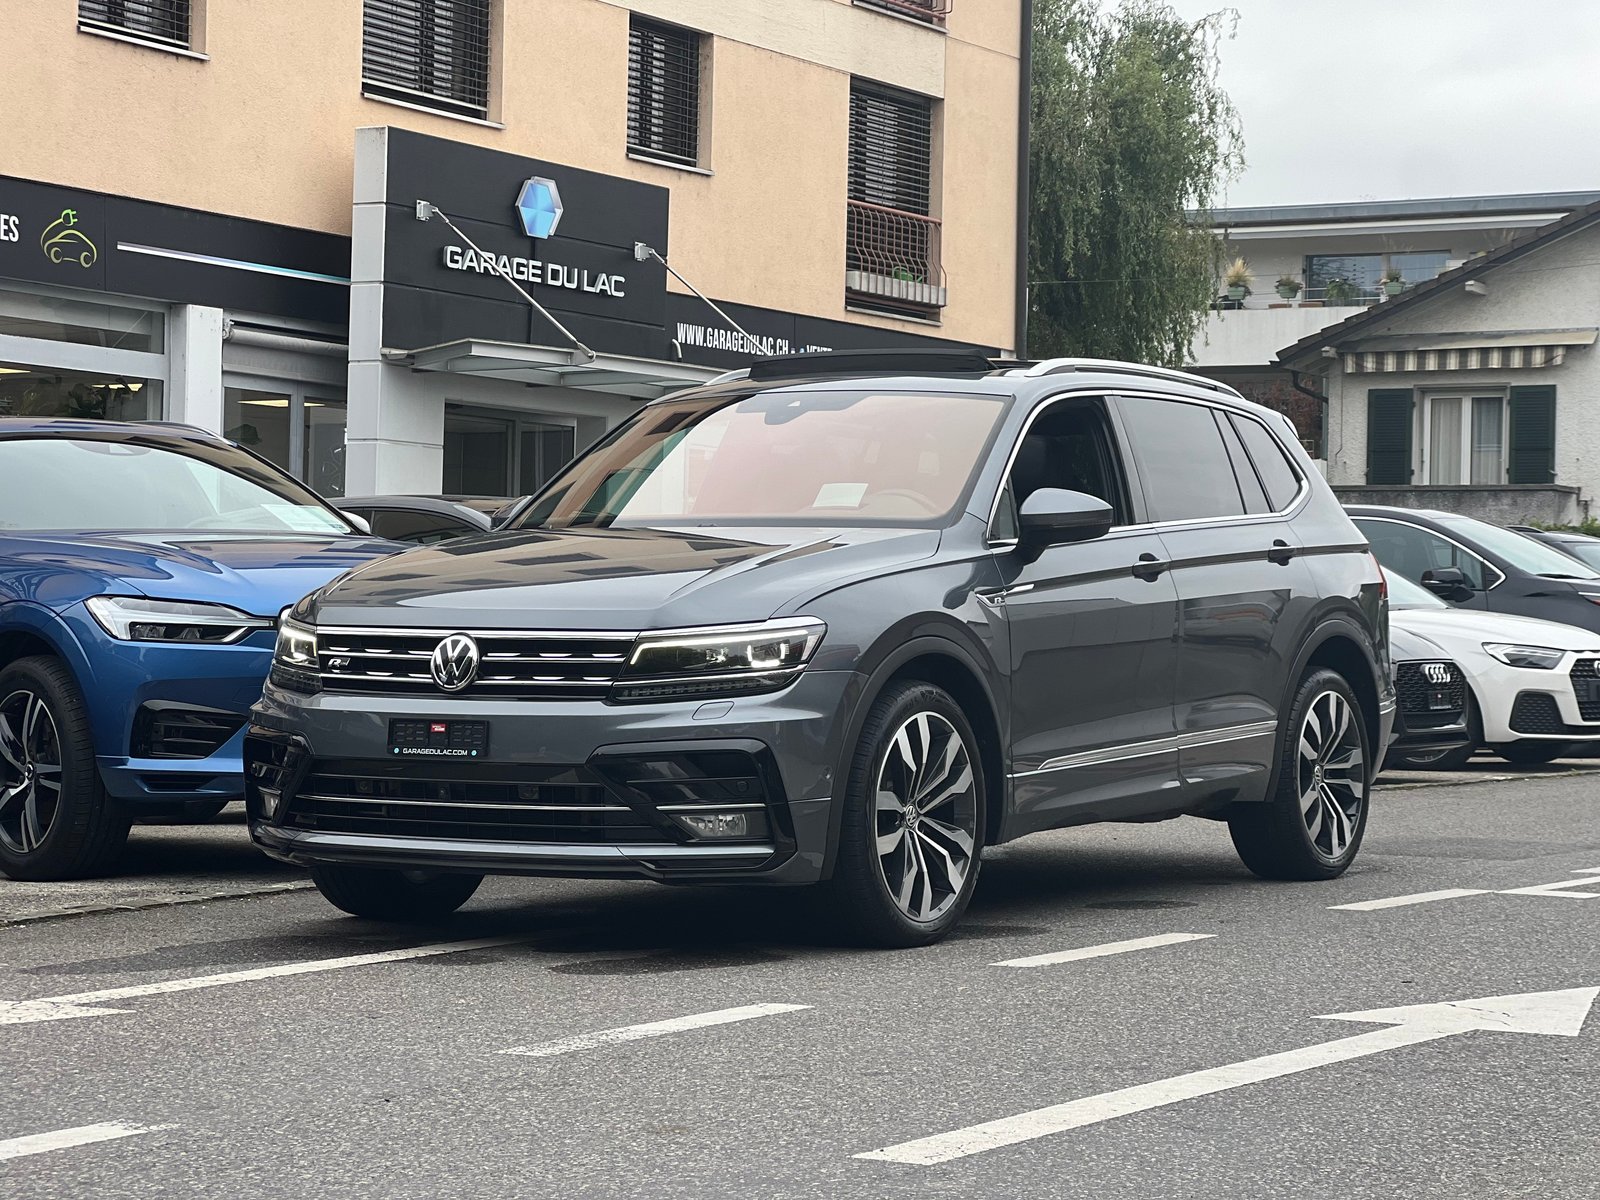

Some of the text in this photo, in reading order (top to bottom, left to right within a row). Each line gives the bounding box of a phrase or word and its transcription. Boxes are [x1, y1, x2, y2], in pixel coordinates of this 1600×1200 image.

[443, 245, 626, 298] GARAGE DU LAC
[676, 322, 789, 356] WWW.GARAGEDULAC.CH
[402, 747, 468, 756] GARAGEDULAC.COM
